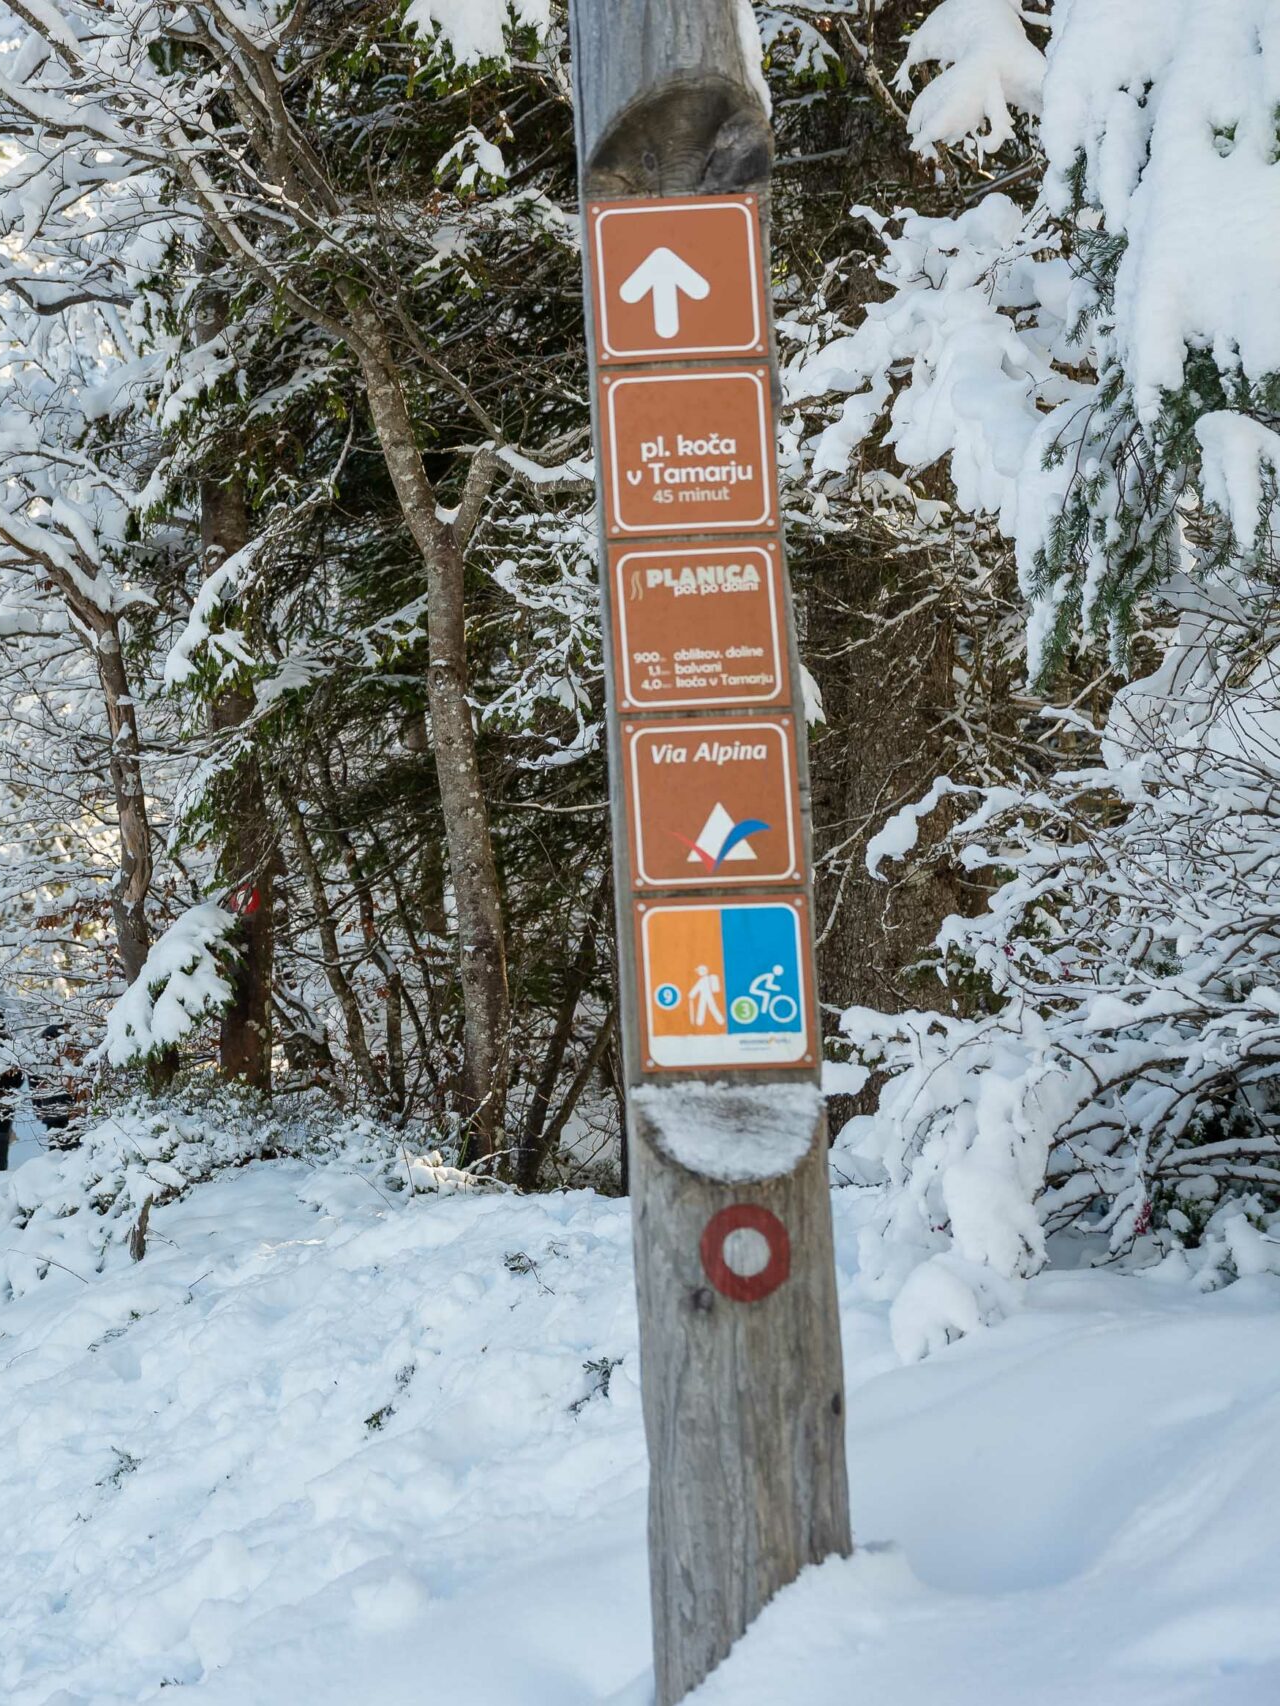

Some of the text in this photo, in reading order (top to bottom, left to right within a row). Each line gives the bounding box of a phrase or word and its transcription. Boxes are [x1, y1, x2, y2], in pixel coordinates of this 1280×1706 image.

[641, 433, 736, 461] pl. koča
[627, 461, 752, 485] v Tamarju
[652, 486, 731, 504] 45 minut
[646, 564, 760, 588] PLANICA
[633, 651, 660, 664] 900
[720, 672, 774, 687] Tamarju
[651, 741, 767, 765] Via Alpina
[663, 989, 673, 1004] 9
[740, 1002, 751, 1017] 3
